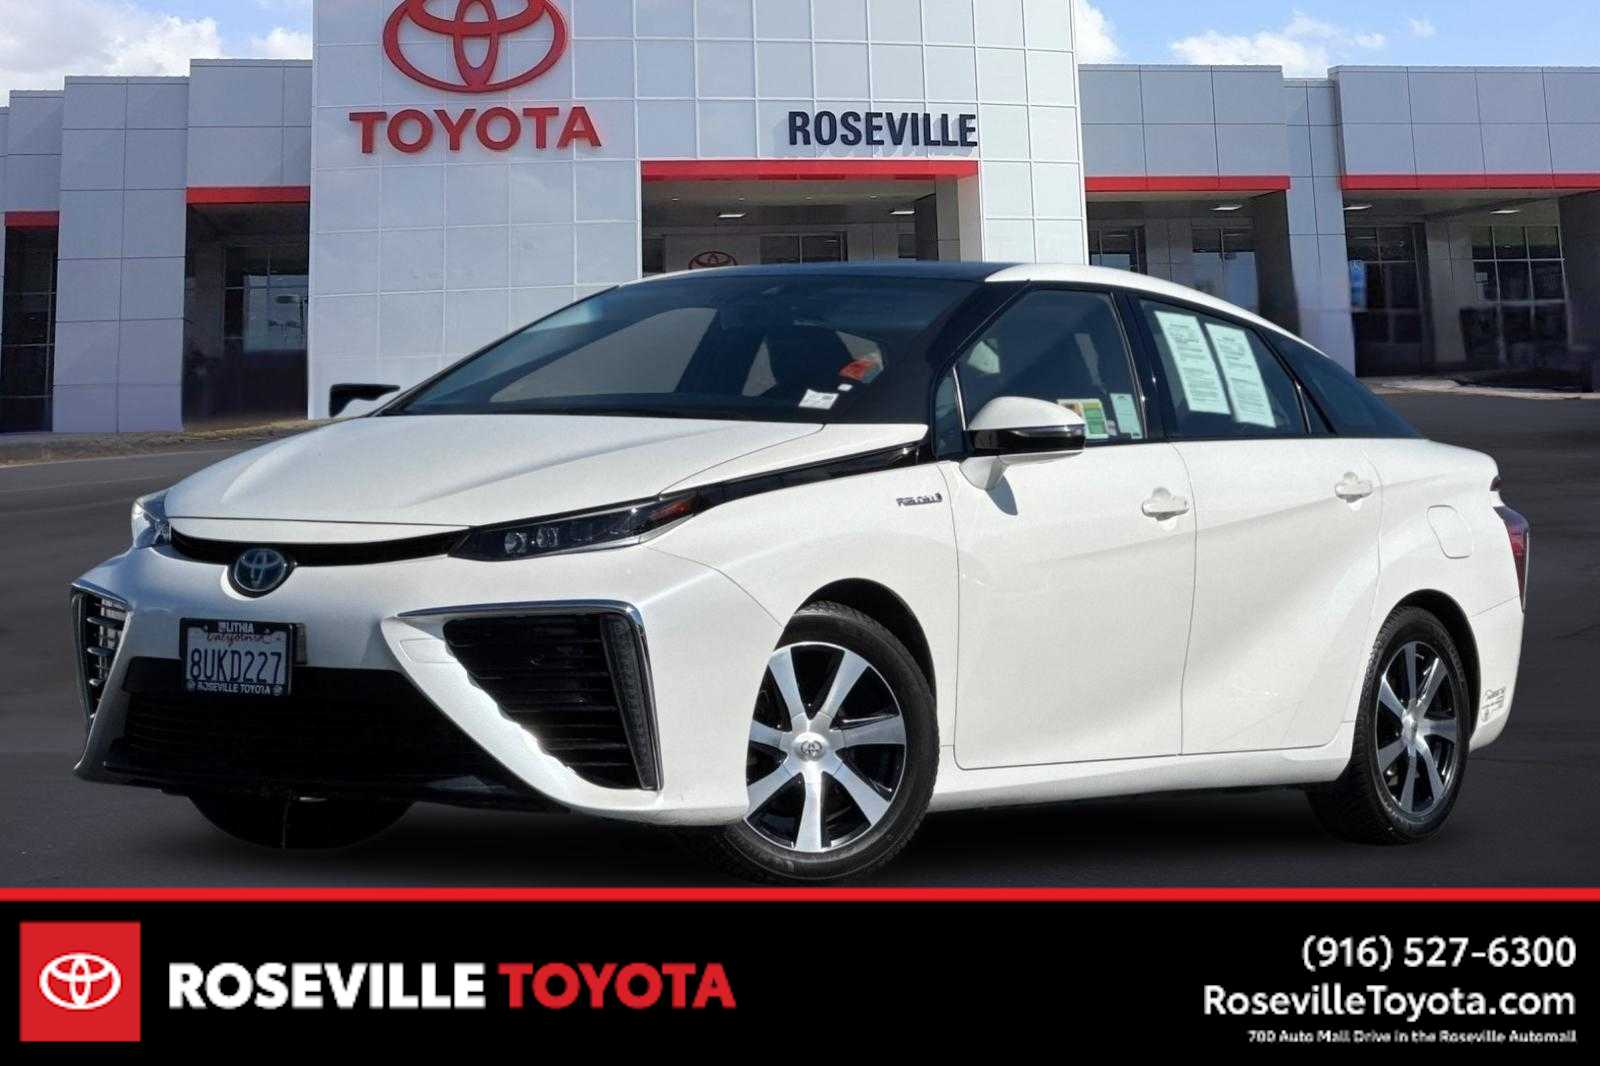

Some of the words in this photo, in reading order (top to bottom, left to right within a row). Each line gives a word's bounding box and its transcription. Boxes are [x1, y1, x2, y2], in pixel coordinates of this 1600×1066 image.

[349, 106, 602, 154] TOYOTA
[788, 111, 978, 147] ROSEVILLE
[190, 648, 282, 684] 8UKD227
[240, 683, 271, 695] TOYOTA
